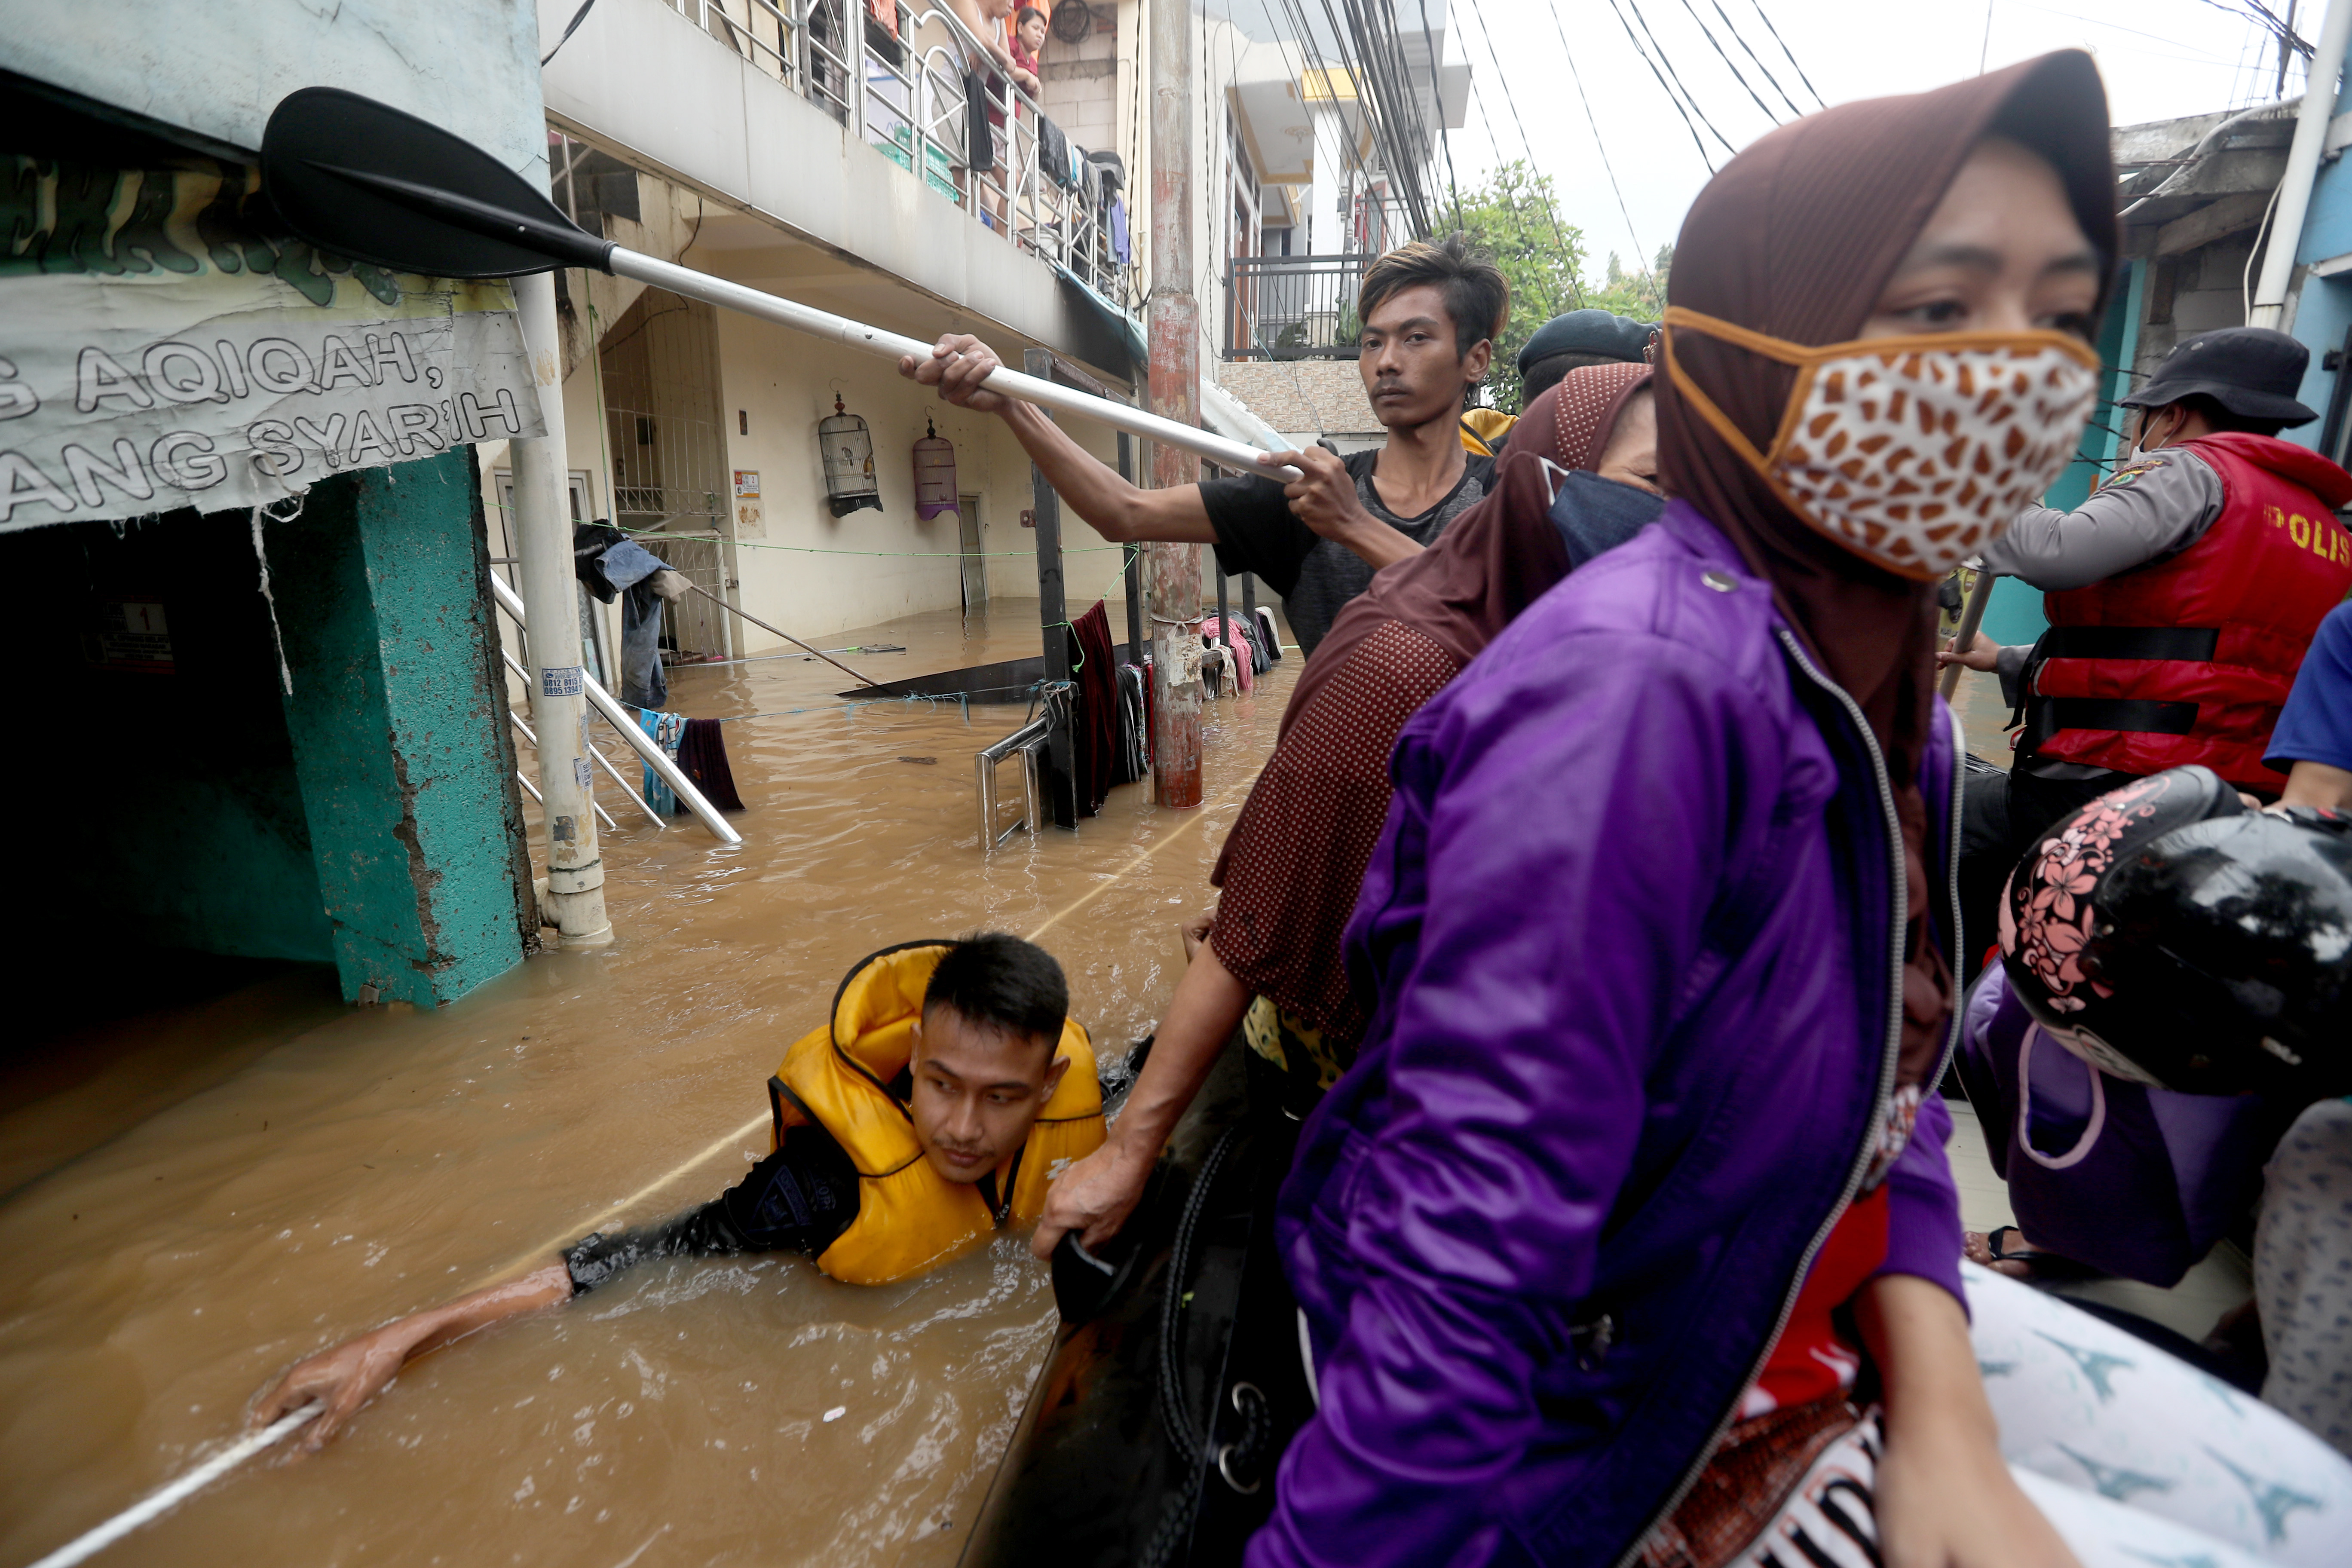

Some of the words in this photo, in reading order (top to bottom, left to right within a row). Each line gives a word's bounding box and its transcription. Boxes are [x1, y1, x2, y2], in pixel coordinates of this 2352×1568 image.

[75, 331, 443, 413] AQIQAH,
[140, 607, 150, 631] 1
[564, 678, 578, 686] 8115
[564, 686, 578, 694] 1394
